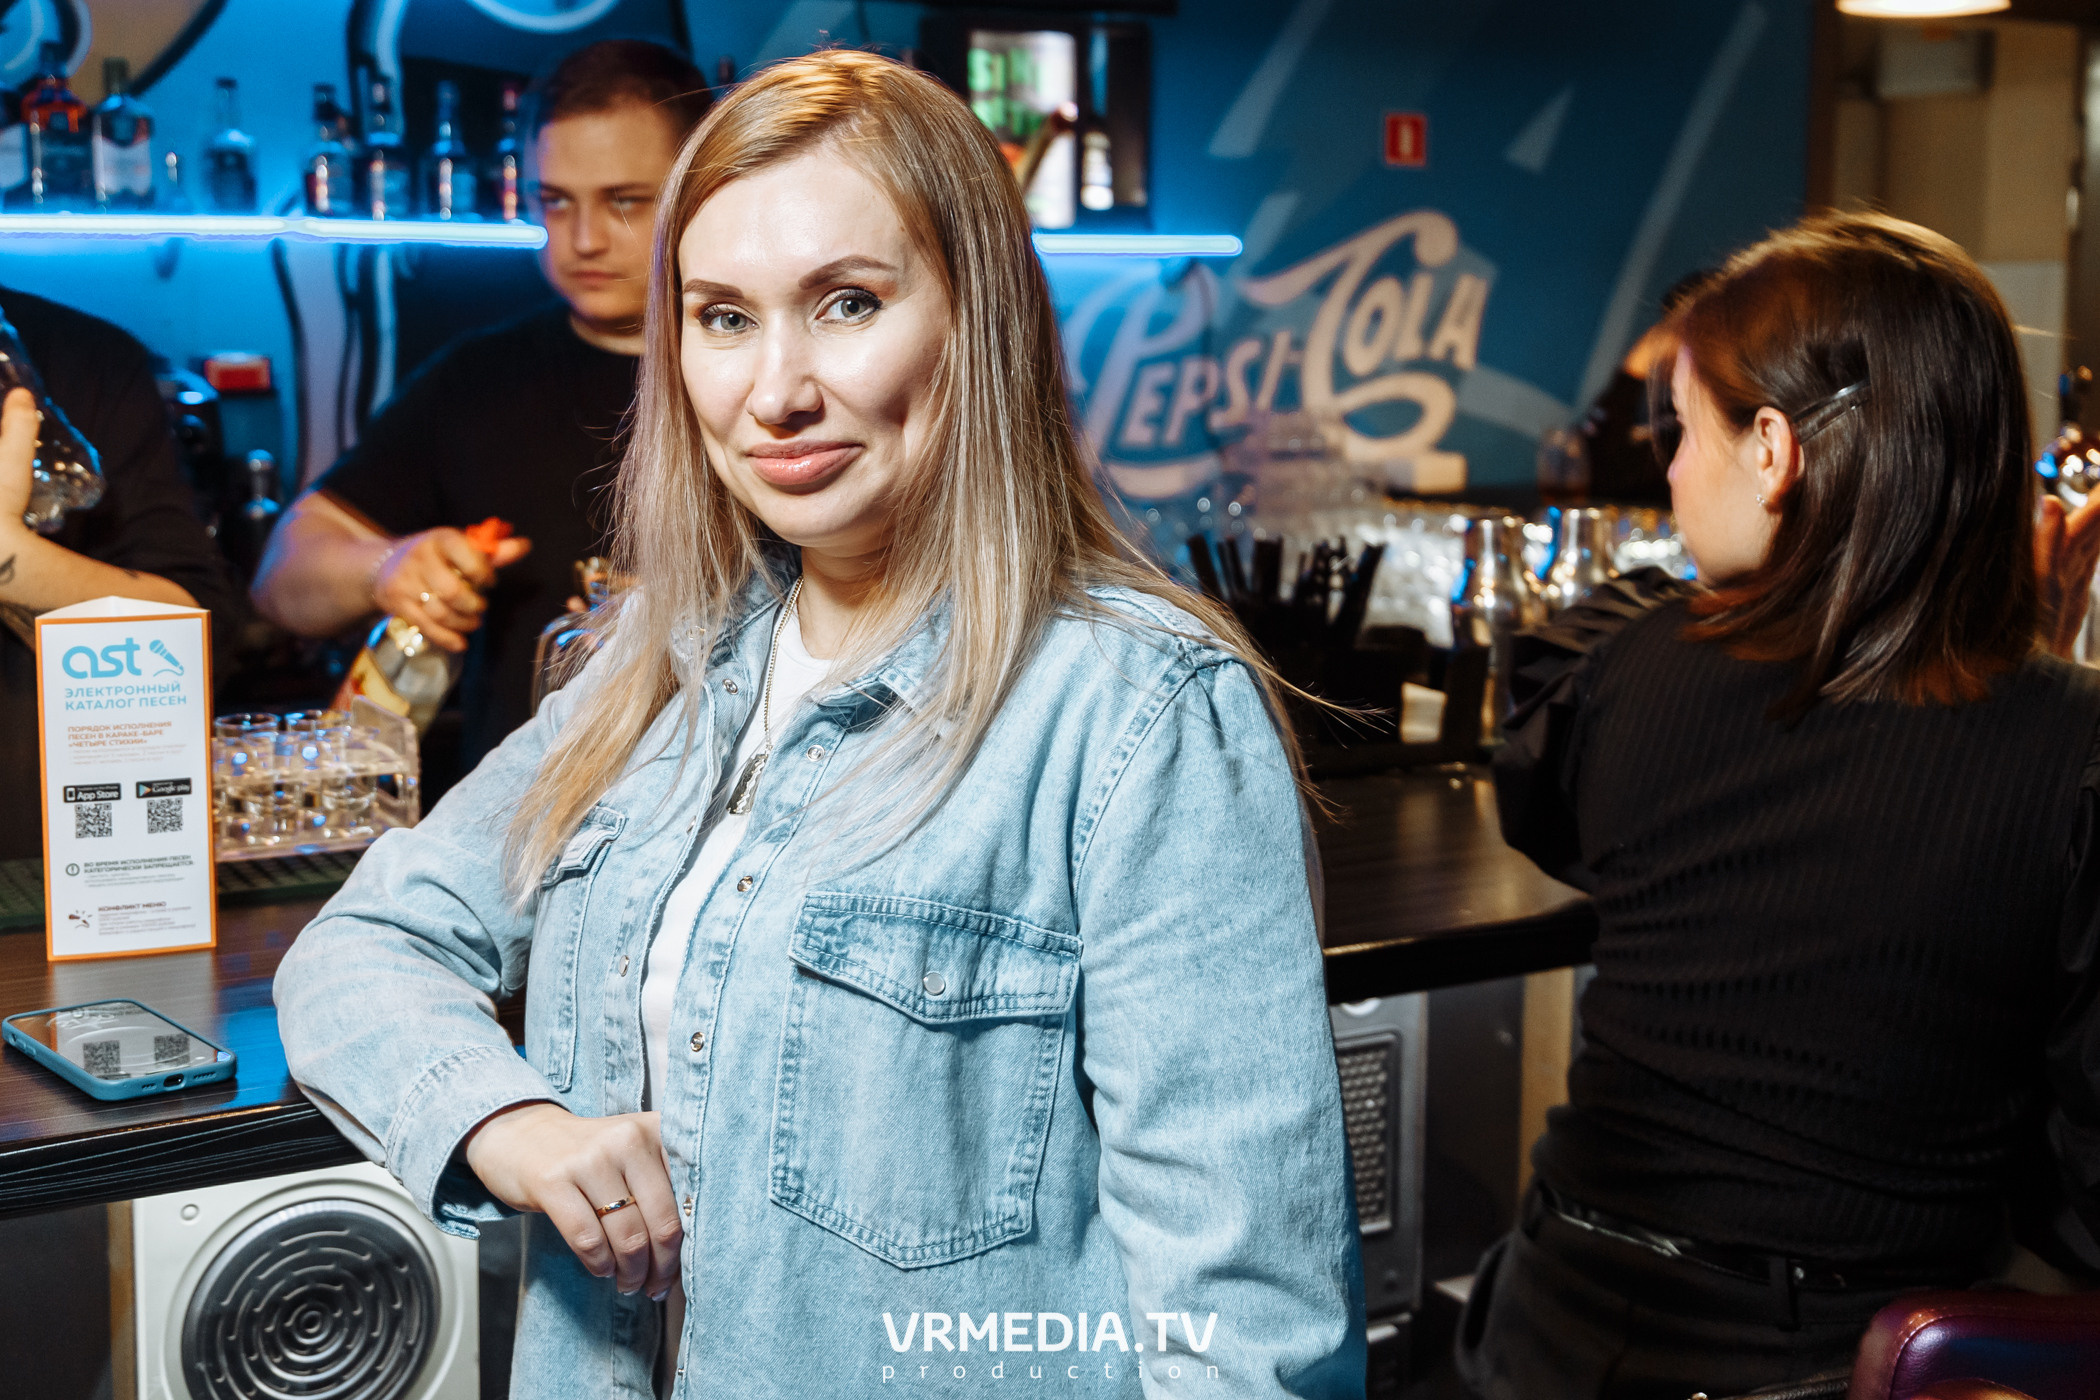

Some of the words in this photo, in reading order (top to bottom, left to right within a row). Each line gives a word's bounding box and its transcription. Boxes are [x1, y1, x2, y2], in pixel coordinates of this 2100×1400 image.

[62, 637, 142, 679] ast
[65, 681, 181, 698] ЭЛЕКТРОННЫЙ
[65, 698, 136, 711] КАТАЛОГ
[139, 695, 187, 708] ПЕСЕН
[68, 724, 112, 733] ПОРЯДОК
[113, 721, 172, 731] ИСПОЛНЕНИЯ
[77, 791, 96, 801] App
[96, 790, 119, 800] Store
[152, 784, 176, 794] Google
